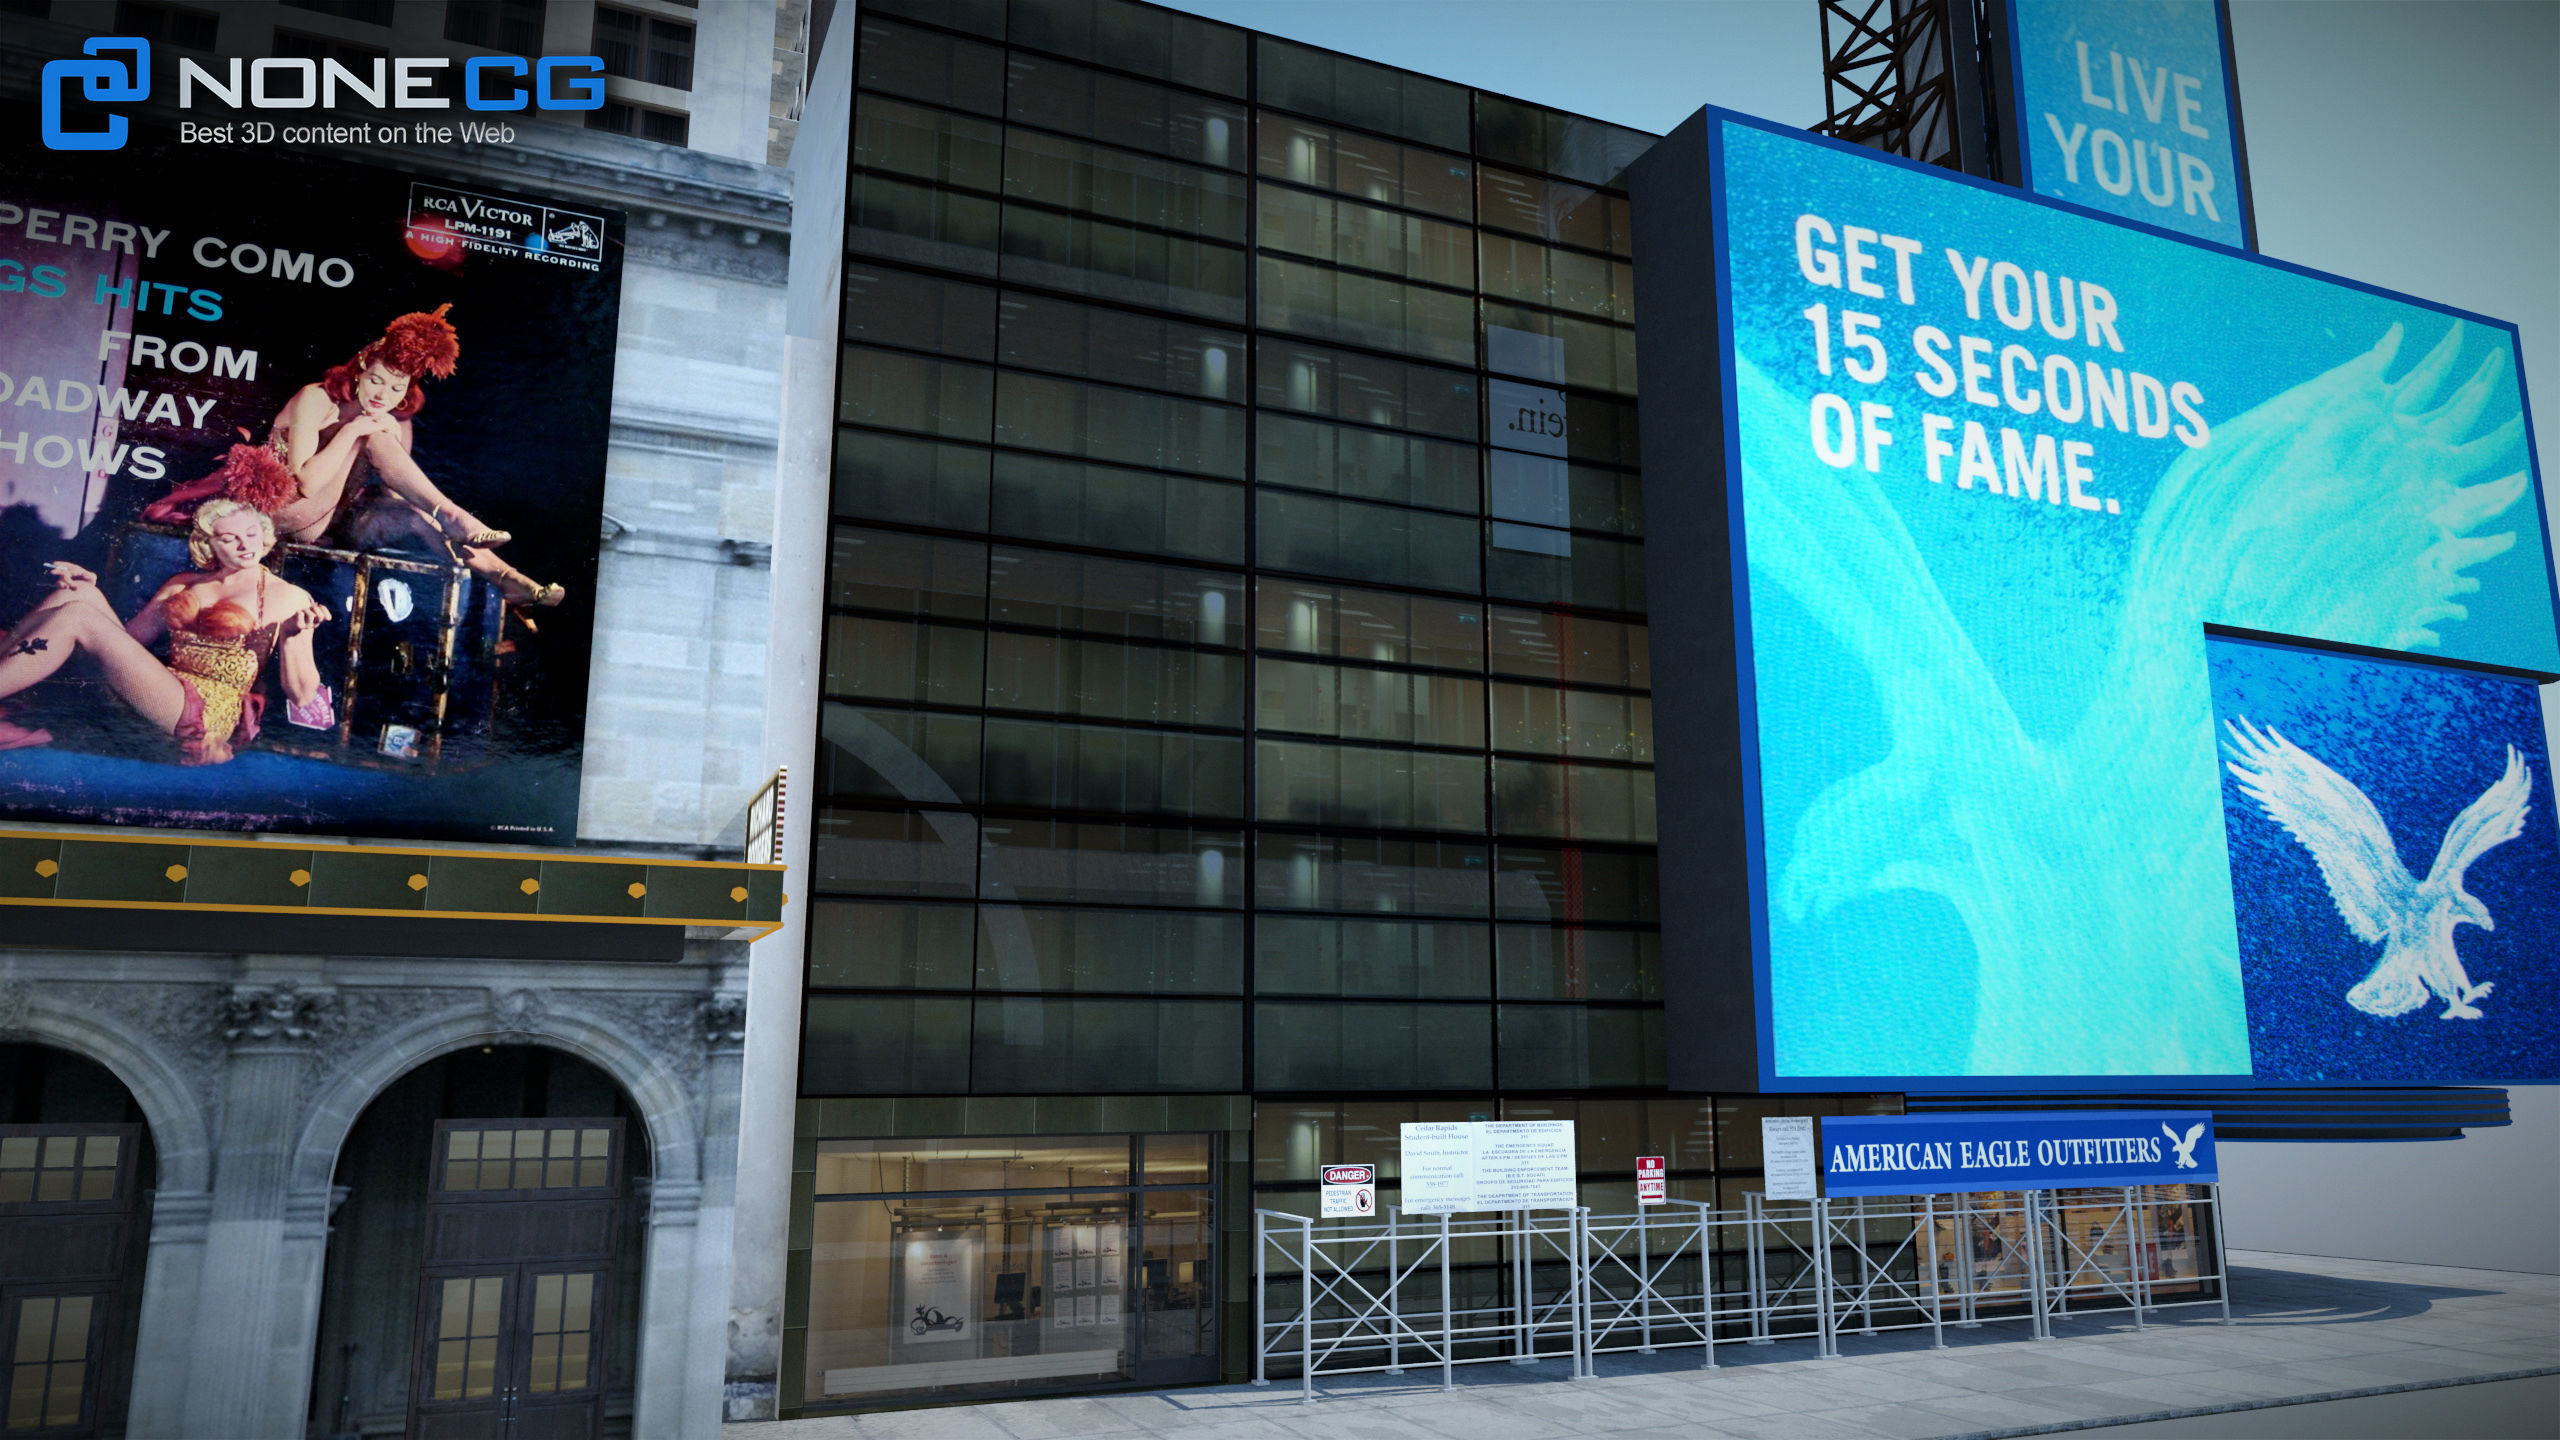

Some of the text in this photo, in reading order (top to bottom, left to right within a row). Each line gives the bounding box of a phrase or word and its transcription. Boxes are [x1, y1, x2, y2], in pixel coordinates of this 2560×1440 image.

[2076, 40, 2211, 140] LIVE
[2044, 112, 2221, 223] YOUR
[423, 196, 533, 227] RCA VICTOR
[445, 219, 512, 240] LPM-1191
[193, 236, 354, 288] COMO
[405, 231, 600, 272] A HIGH FIDELITY RECORDING
[94, 273, 224, 322] HITS
[1795, 214, 2124, 353] GET YOUR
[98, 330, 258, 382] FROM
[1803, 303, 2210, 450] 15 SECONDS
[1810, 393, 2121, 515] OF FAME.
[1436, 1124, 1458, 1132] Rapids
[1638, 1169, 1664, 1178] PARKING
[1646, 1159, 1655, 1169] NO
[1830, 1136, 2162, 1173] AMERICAN EAGLE OUTFITTERS
[1640, 1182, 1664, 1192] ANYTIME
